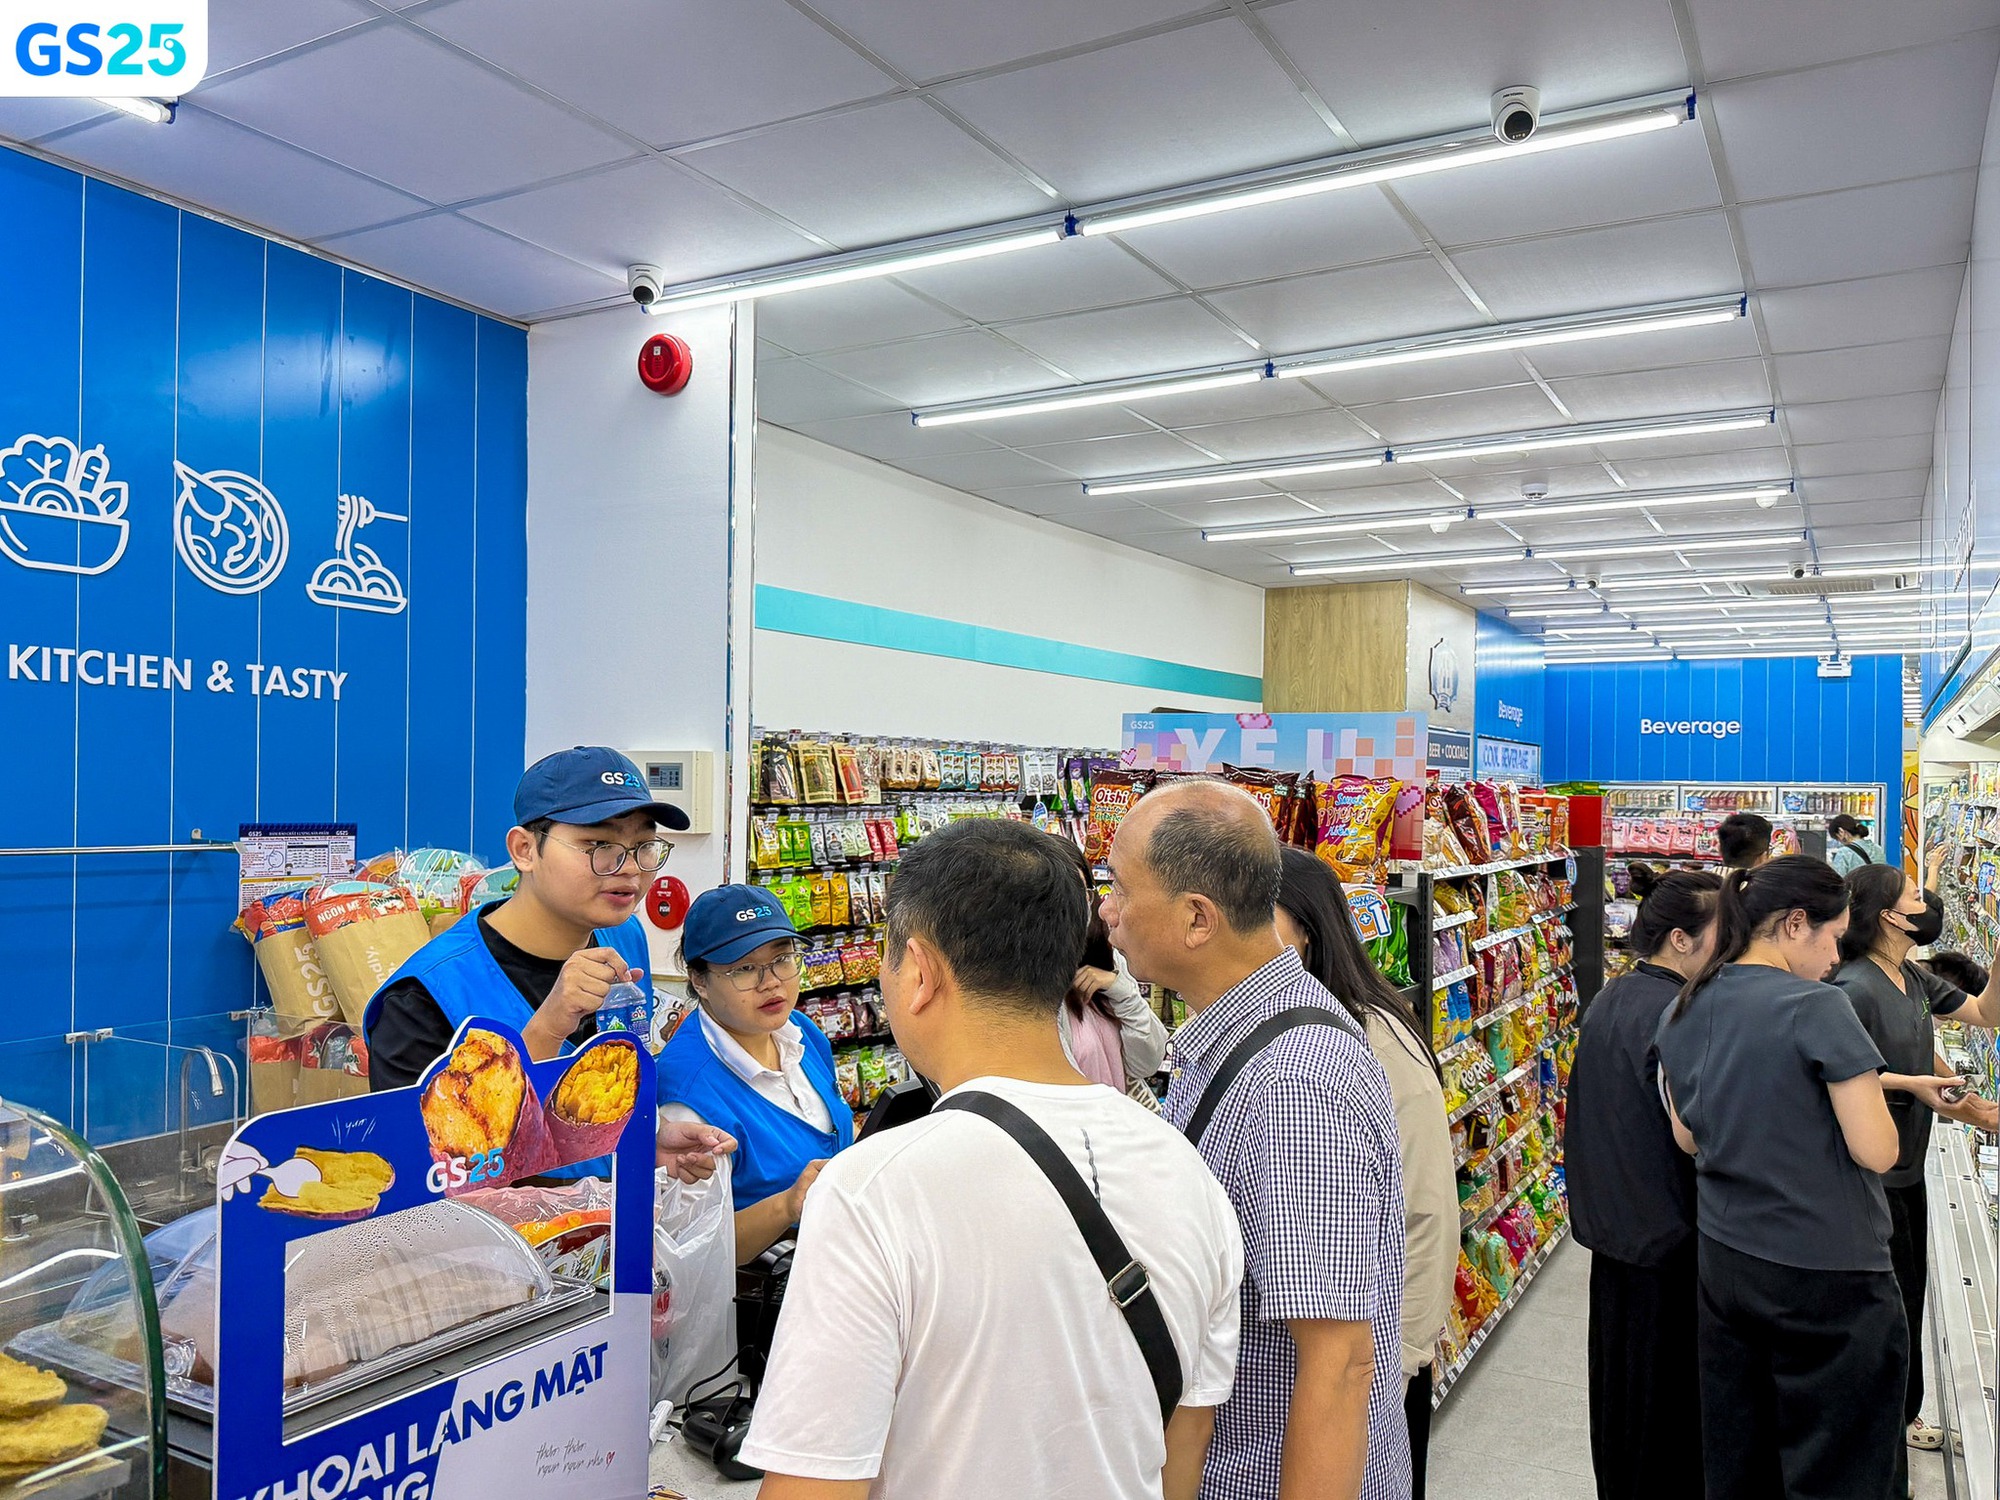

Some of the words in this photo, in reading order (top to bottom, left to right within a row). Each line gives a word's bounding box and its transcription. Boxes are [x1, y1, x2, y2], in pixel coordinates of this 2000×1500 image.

[8, 644, 192, 691] KITCHEN
[206, 660, 234, 693] &
[246, 663, 348, 700] TASTY
[1498, 700, 1523, 727] Beverage
[1130, 721, 1155, 729] GS25
[1640, 719, 1740, 739] Beverage
[1429, 742, 1441, 758] BEER
[1445, 744, 1469, 760] COCKTAILS
[601, 771, 640, 788] GS25
[1094, 787, 1129, 805] Oishi
[736, 906, 772, 921] GS25
[294, 942, 339, 1017] GS25
[426, 1147, 505, 1194] GS25
[232, 1432, 396, 1500] HOAI
[408, 1380, 524, 1465] LANG
[531, 1341, 609, 1409] MẬT
